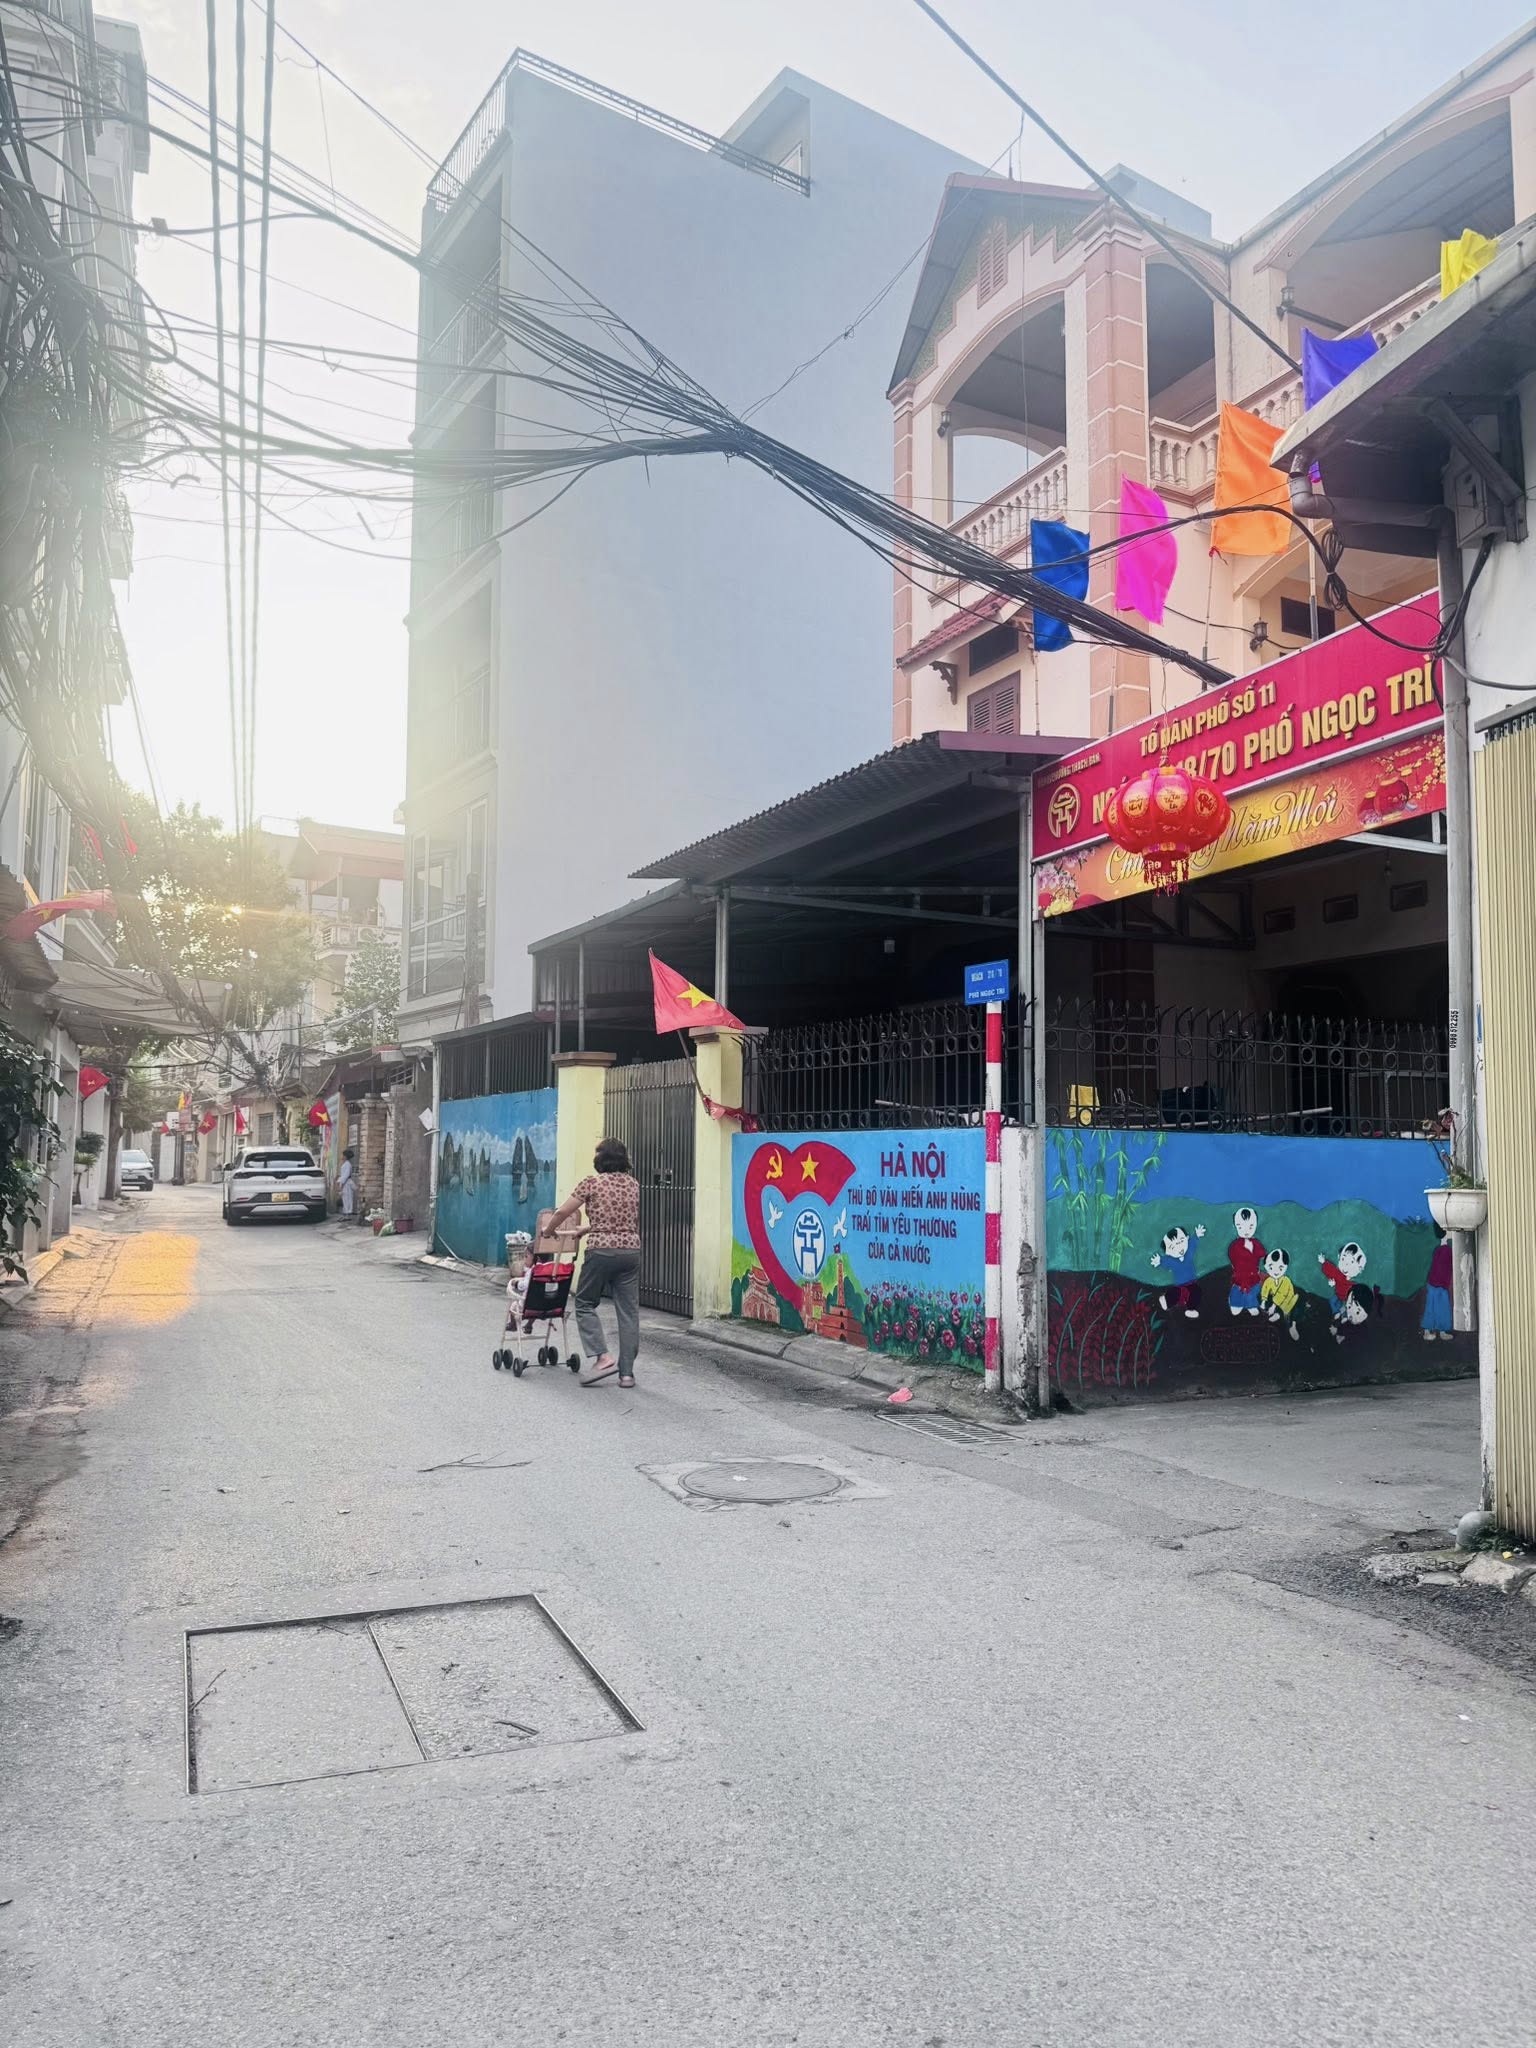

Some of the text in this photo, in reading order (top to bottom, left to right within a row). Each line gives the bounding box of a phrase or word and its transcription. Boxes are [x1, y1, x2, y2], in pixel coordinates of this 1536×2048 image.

[1195, 691, 1231, 734] PHỐ
[1231, 679, 1258, 719] SỐ
[1258, 681, 1277, 707] 11
[1244, 703, 1298, 769] PHỐ
[1301, 685, 1377, 748] NGỌC
[1386, 654, 1436, 715] TRÌ
[1271, 783, 1345, 837] Mới
[881, 1142, 946, 1185] HÀ NỘI
[847, 1184, 981, 1211] THỦ ĐÔ VĂN HIẾN ANH HÙNG
[852, 1210, 871, 1232] TRÁI
[892, 1212, 911, 1235] YÊU
[913, 1217, 957, 1239] THƯƠNG
[868, 1236, 931, 1264] CỦA CẢ NƯỚC
